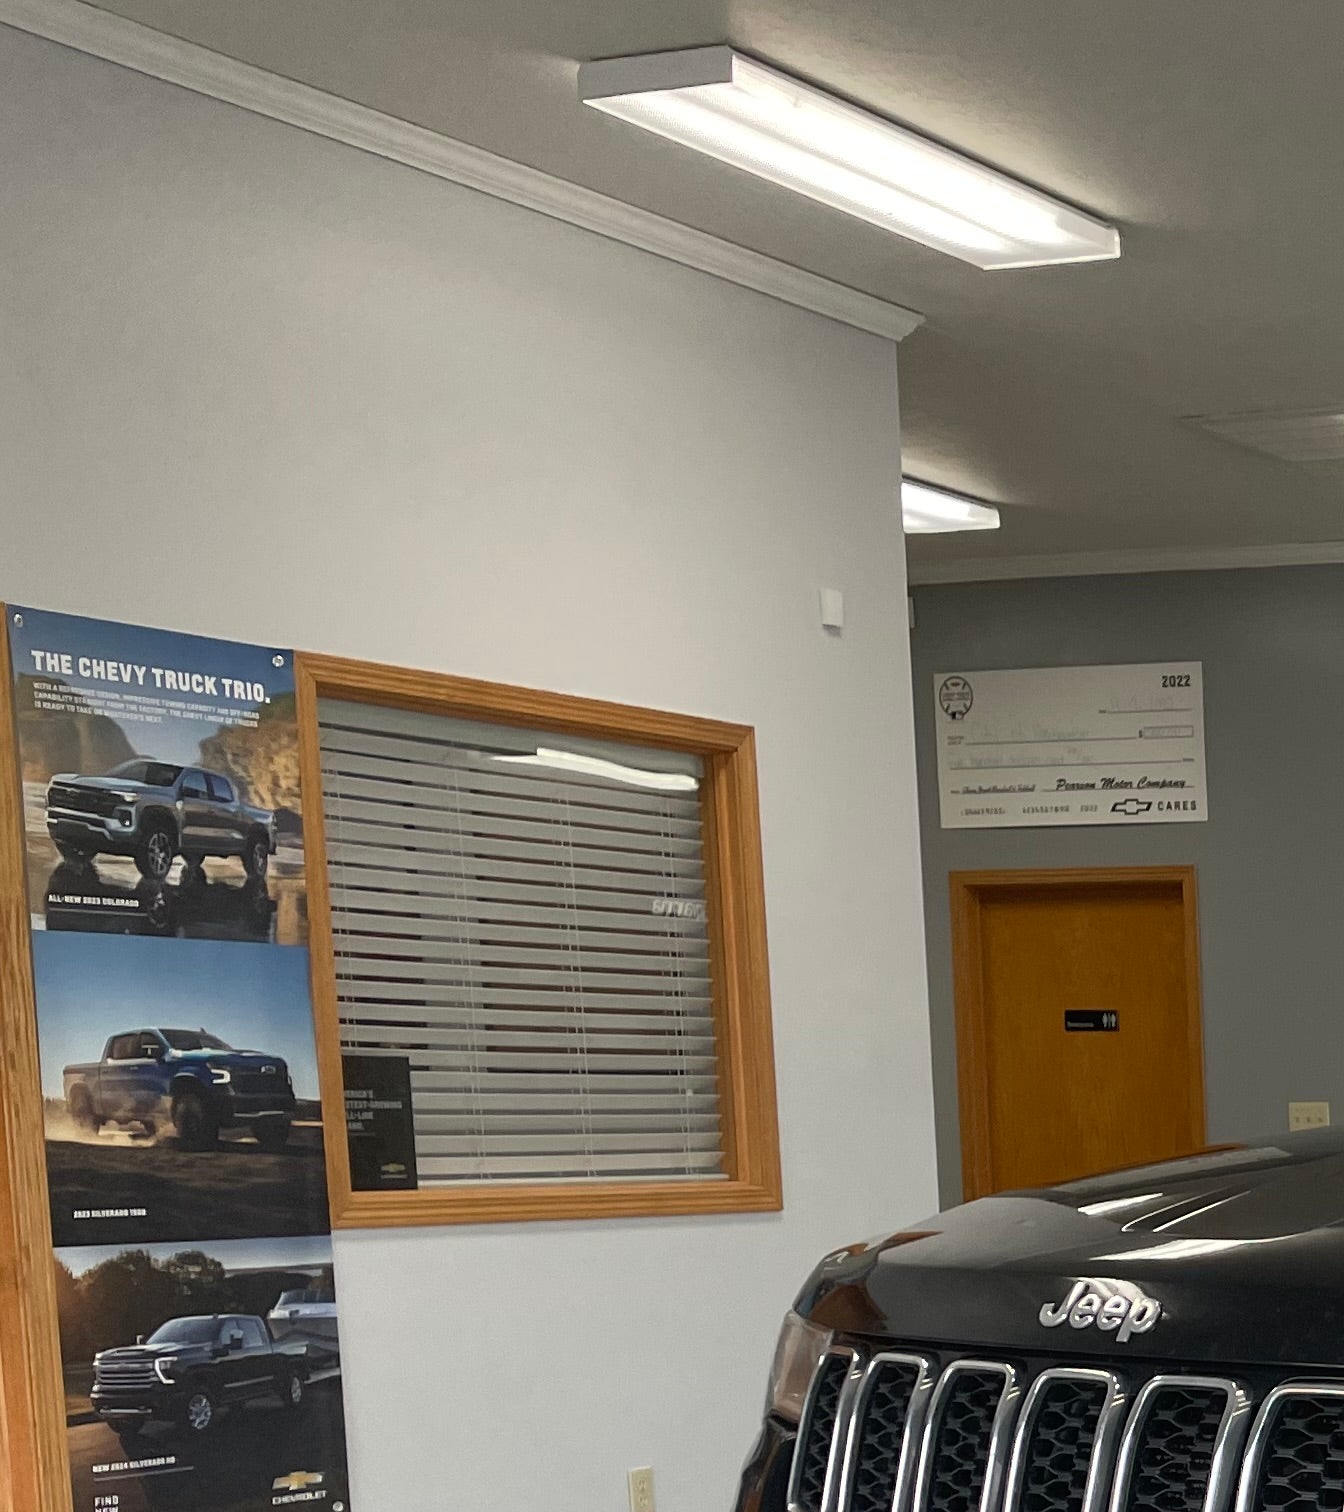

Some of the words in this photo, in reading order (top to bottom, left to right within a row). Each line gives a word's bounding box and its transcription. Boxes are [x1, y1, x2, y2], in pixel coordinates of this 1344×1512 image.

[31, 650, 73, 675] THE
[79, 657, 147, 686] CHEVY
[151, 668, 218, 696] TRUCK
[221, 678, 271, 704] TRIO.
[1161, 674, 1191, 688] 2022
[1100, 777, 1133, 790] Motor
[1136, 776, 1187, 789] Company
[1157, 800, 1197, 812] CARES
[1038, 1281, 1162, 1343] Jeep
[94, 1494, 119, 1507] FIND
[272, 1489, 327, 1505] CHEVROLET
